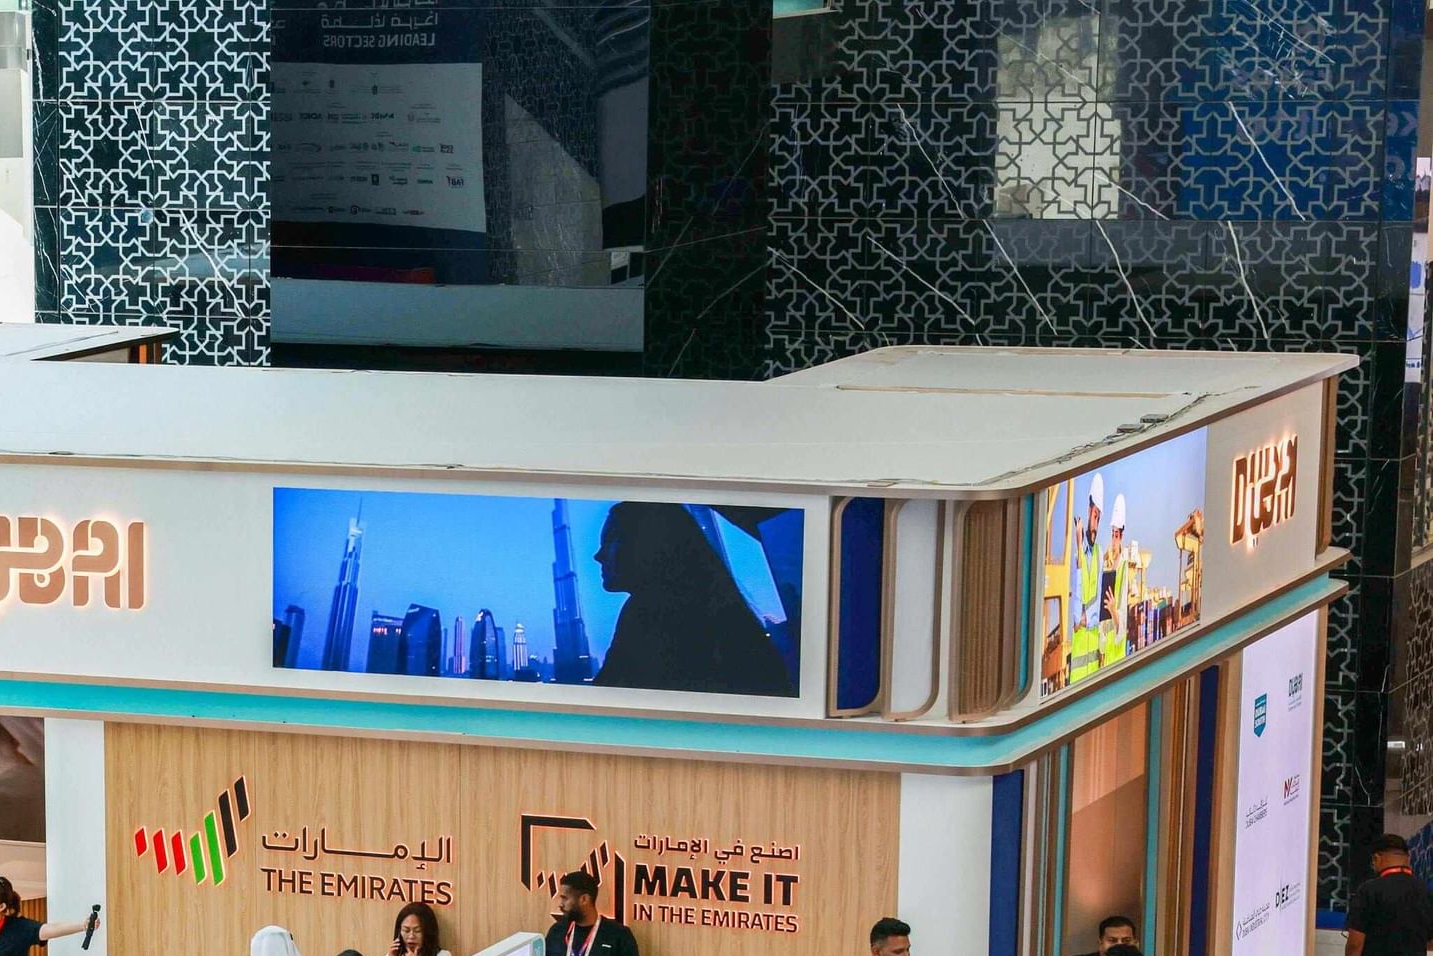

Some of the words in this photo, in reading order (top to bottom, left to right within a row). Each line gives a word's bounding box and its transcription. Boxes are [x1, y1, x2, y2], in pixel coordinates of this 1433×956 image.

[262, 826, 452, 870] الإمارات
[634, 834, 709, 860] الإمارات
[714, 840, 746, 865] في
[750, 841, 800, 864] اصنع
[261, 867, 313, 895] THE
[320, 870, 453, 906] EMIRATES
[633, 864, 750, 903] MAKE
[764, 873, 799, 906] IT
[634, 903, 653, 921] IN
[658, 905, 696, 924] THE
[701, 908, 798, 933] EMIRATES
